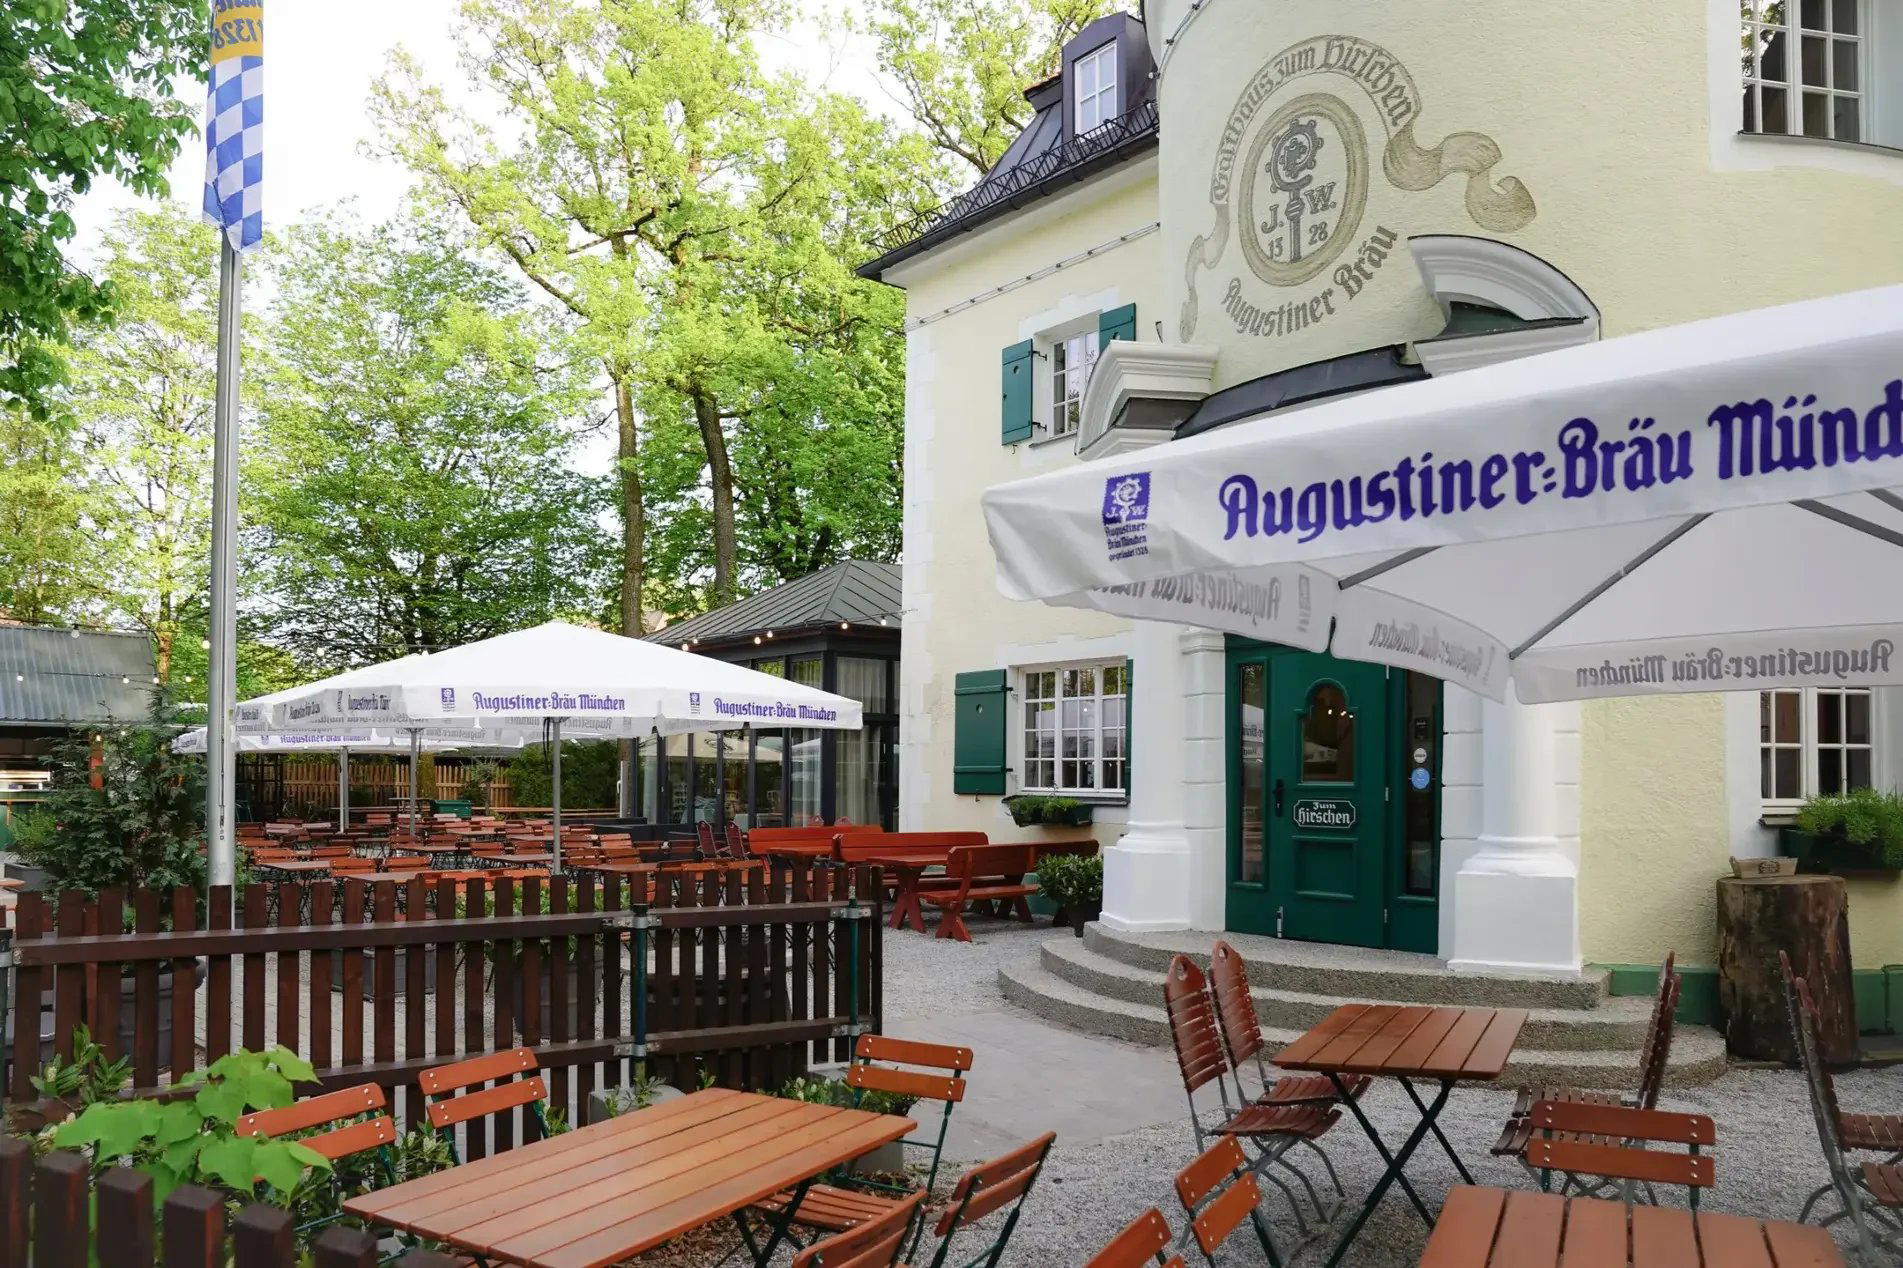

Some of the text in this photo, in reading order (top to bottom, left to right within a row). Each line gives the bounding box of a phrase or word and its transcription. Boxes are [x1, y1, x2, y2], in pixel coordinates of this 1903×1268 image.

[1308, 221, 1329, 246] 28
[1221, 225, 1398, 337] Augustiner Bräu
[578, 693, 626, 711] München
[798, 704, 837, 721] München
[1298, 801, 1351, 825] Zum Hirschen
